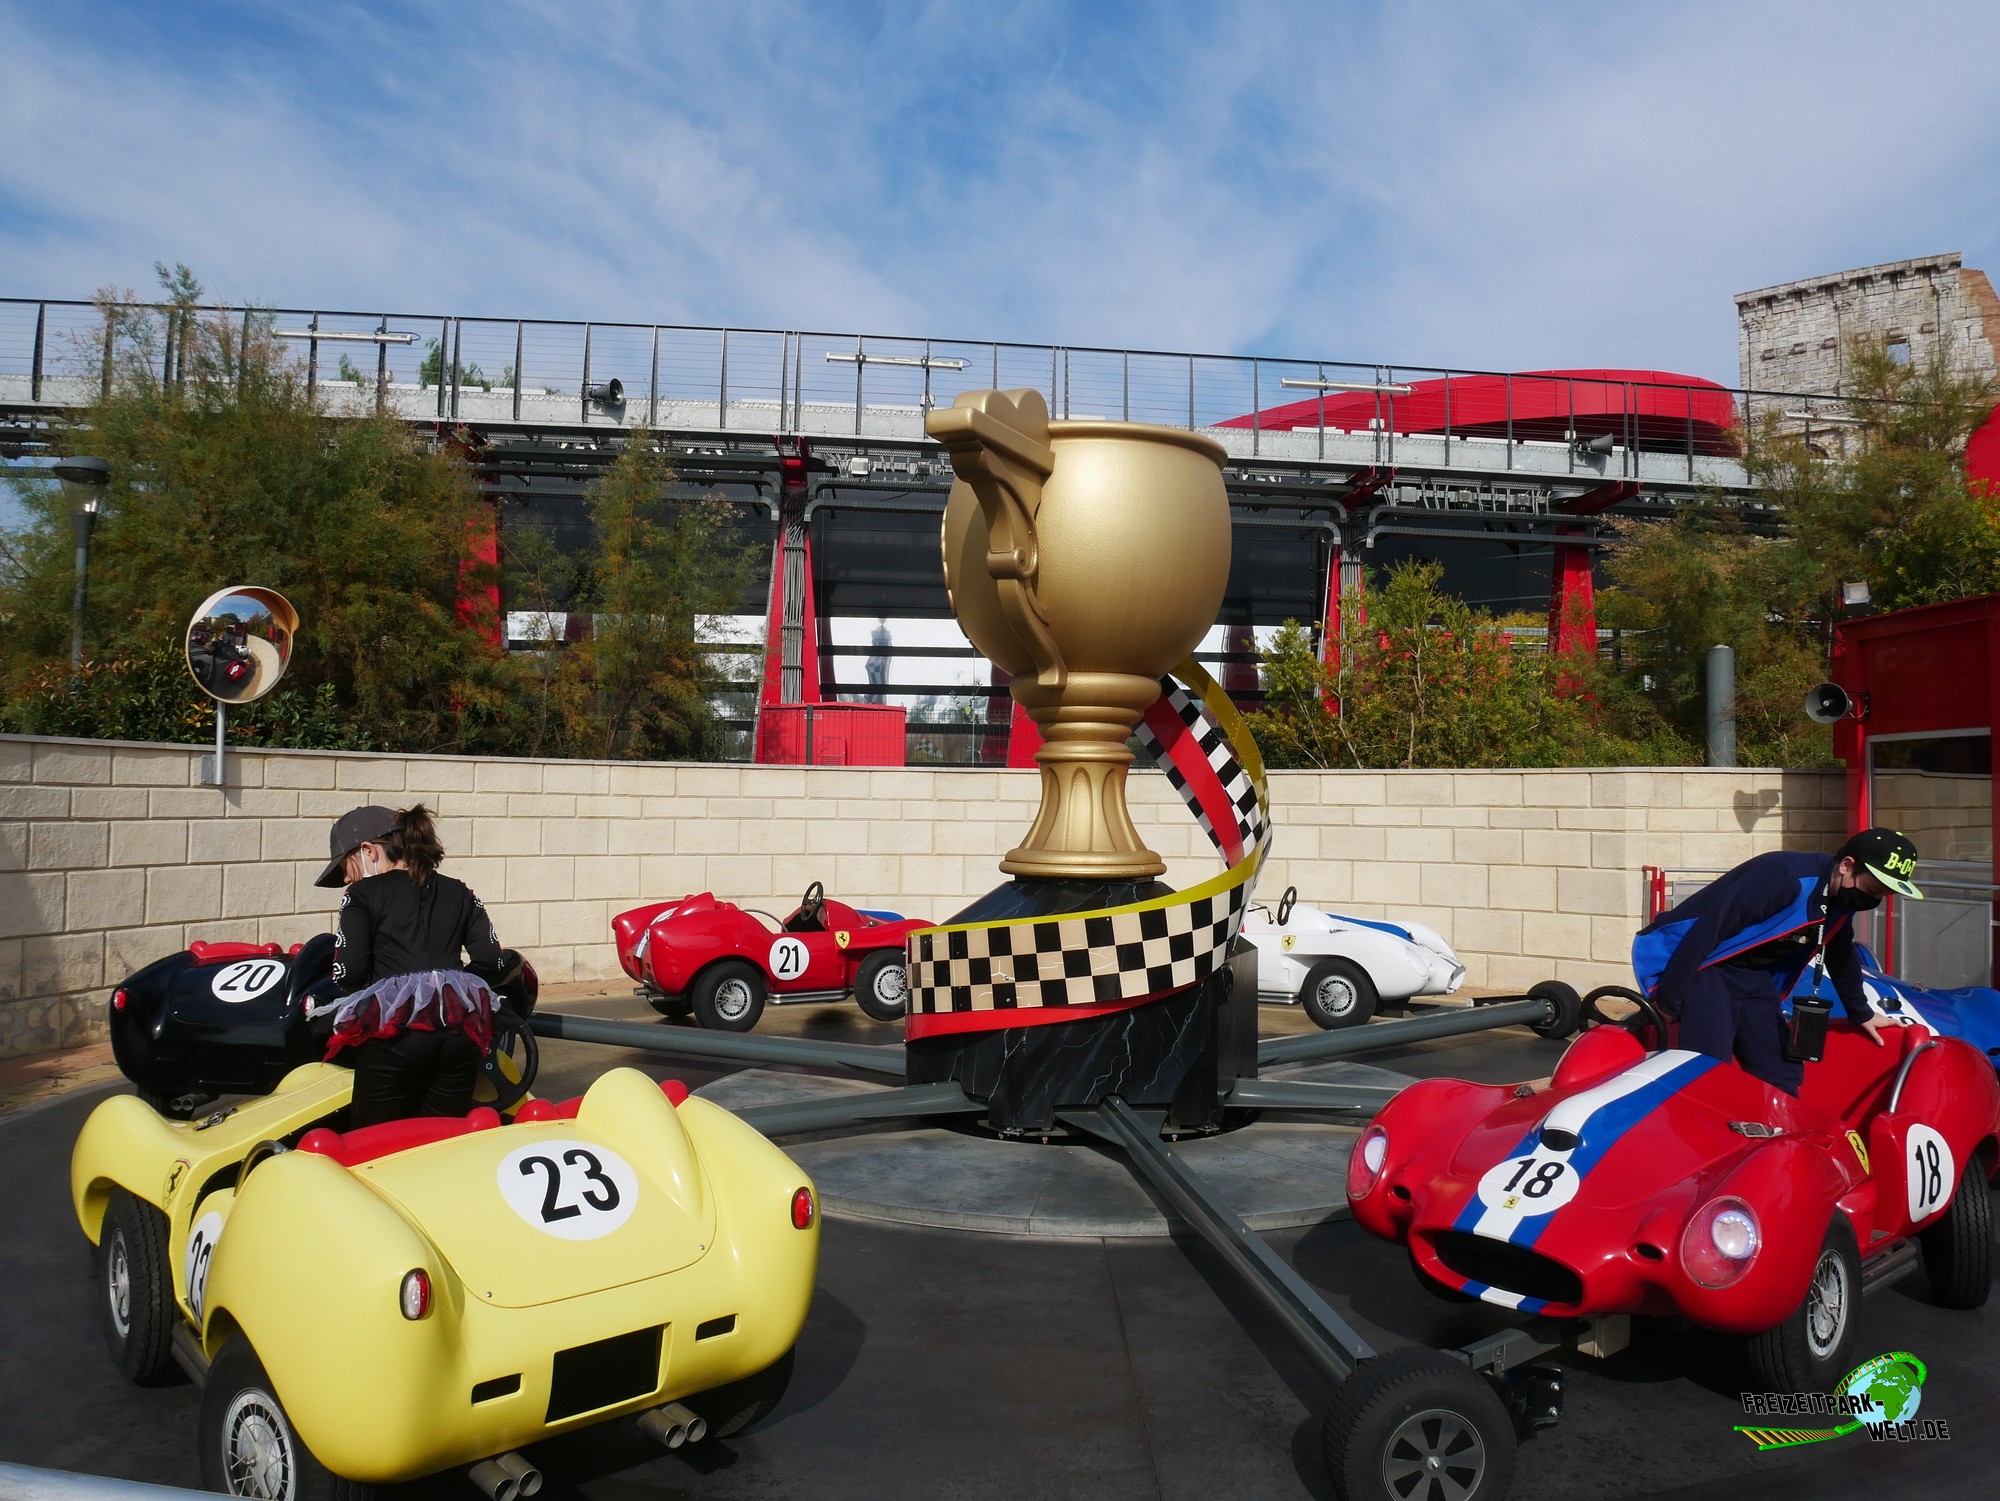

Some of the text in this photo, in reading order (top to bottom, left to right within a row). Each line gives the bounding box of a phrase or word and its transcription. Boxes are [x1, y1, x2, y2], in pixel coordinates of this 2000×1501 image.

[219, 964, 276, 992] 20
[779, 945, 799, 973] 21
[518, 1149, 620, 1223] 23
[1503, 1158, 1565, 1198] 18
[1914, 1140, 1942, 1208] 18
